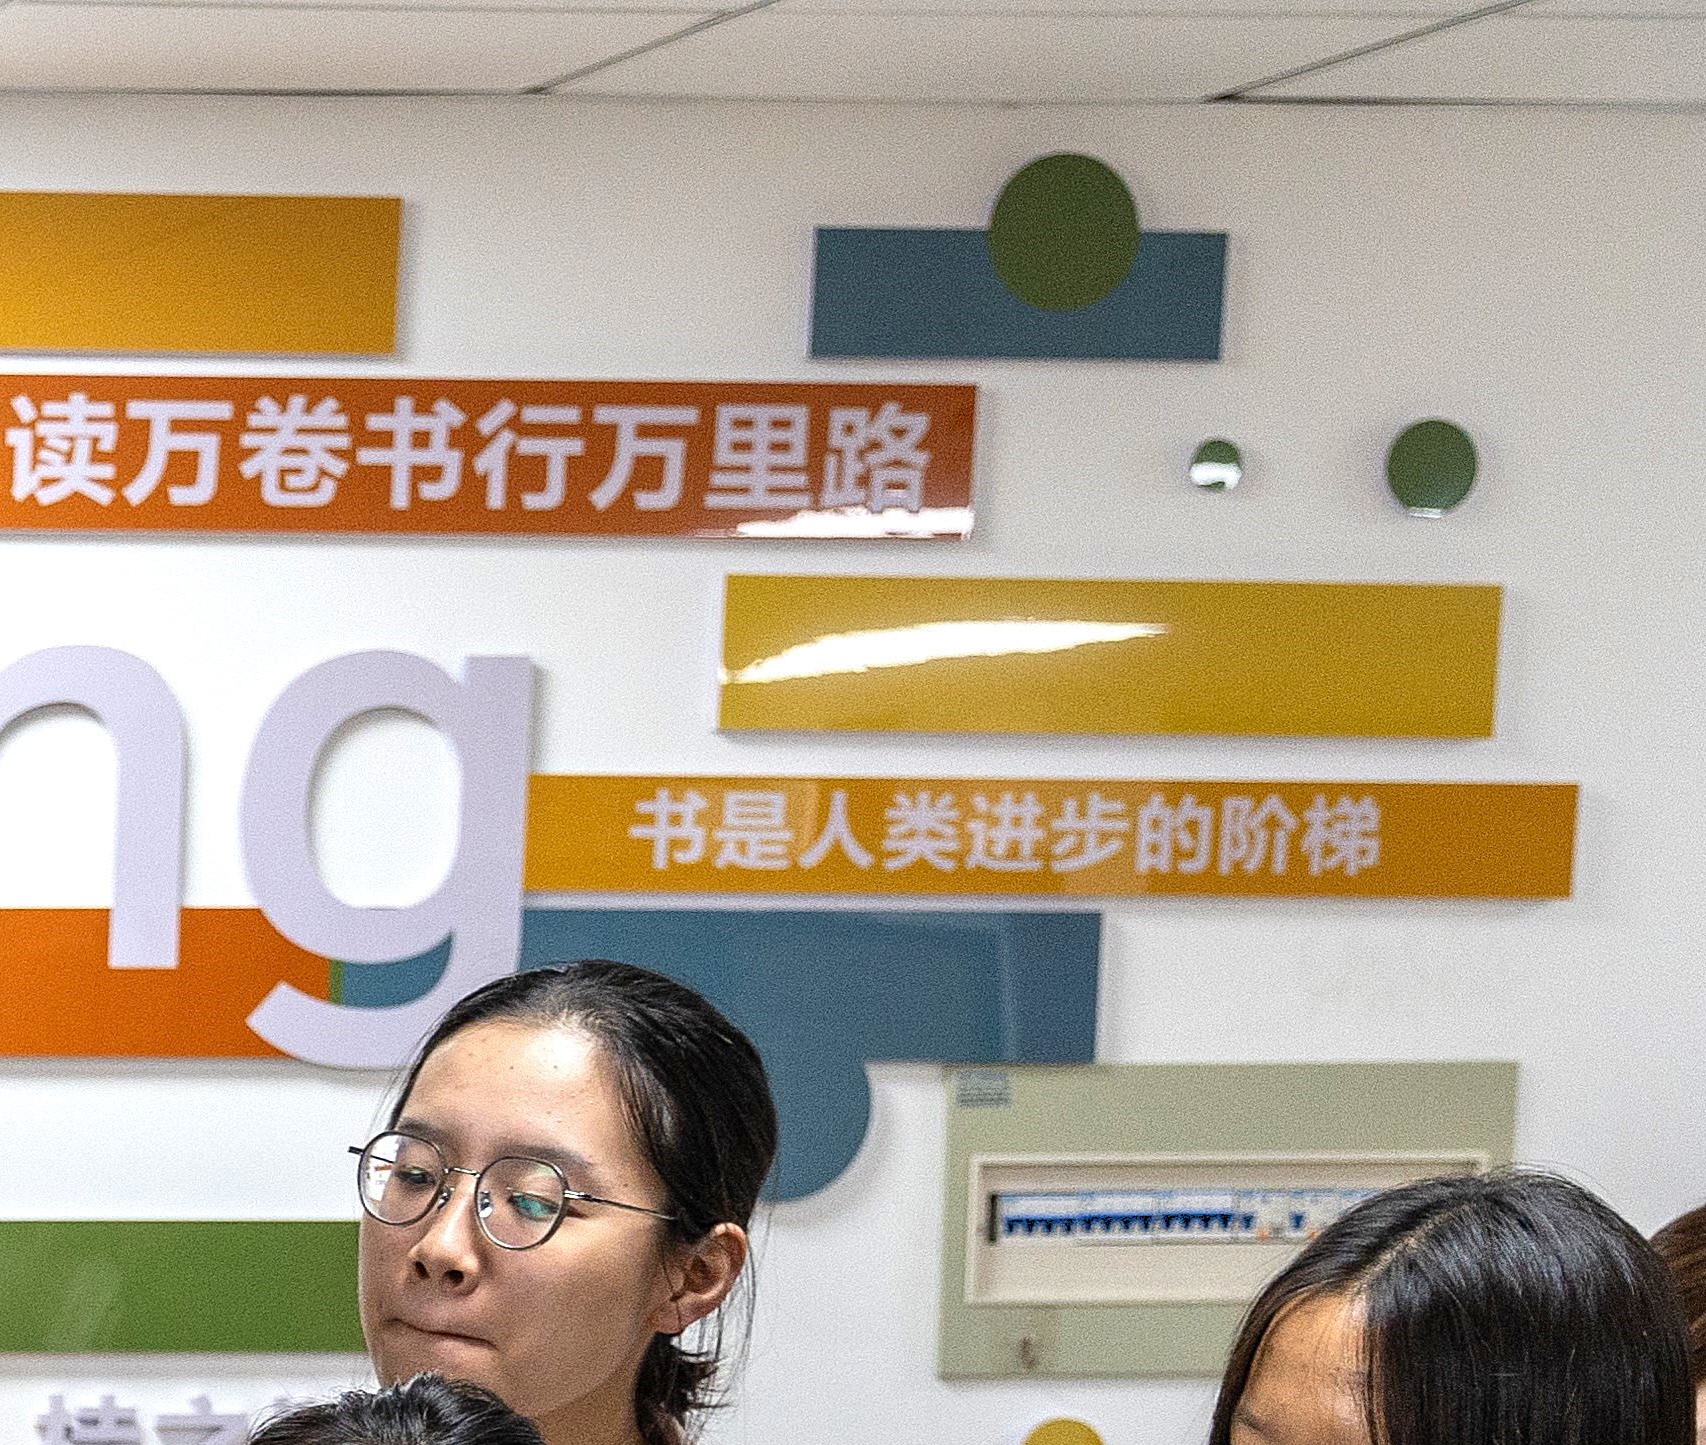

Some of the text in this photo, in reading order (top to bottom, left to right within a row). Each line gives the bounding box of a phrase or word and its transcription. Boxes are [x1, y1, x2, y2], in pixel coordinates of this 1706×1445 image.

[5, 394, 931, 513] 读万卷书行万里路
[629, 788, 1384, 874] 书是人类进步的阶梯
